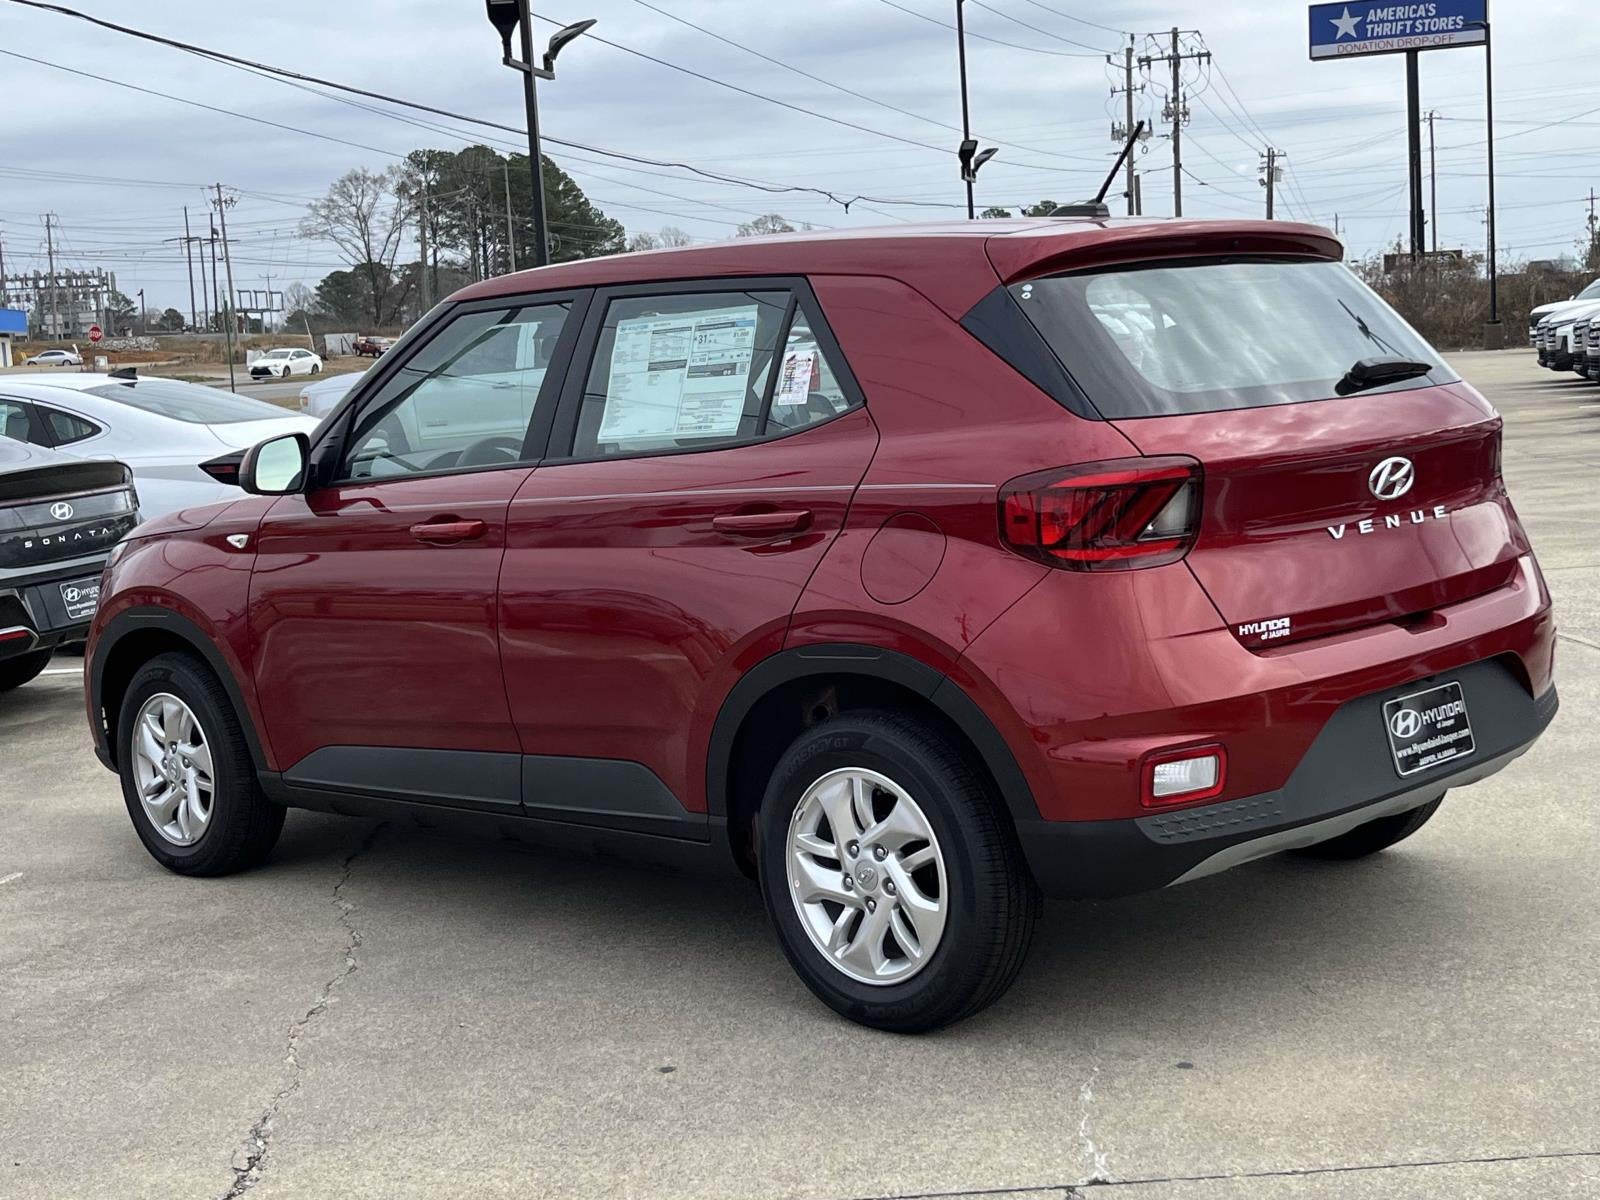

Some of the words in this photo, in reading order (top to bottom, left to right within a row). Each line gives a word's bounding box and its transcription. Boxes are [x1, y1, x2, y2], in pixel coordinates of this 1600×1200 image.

[1366, 4, 1436, 23] AMERICA'S
[1366, 19, 1416, 38] THRIFT
[1415, 16, 1464, 33] STORES
[1336, 37, 1394, 54] DONATION
[1397, 33, 1456, 48] DROP-OFF
[89, 330, 102, 338] STOP
[1327, 505, 1447, 540] VENUE
[24, 527, 110, 549] SONATA
[1239, 617, 1291, 636] HYUNDAI
[1268, 628, 1291, 639] JASPER
[1421, 700, 1465, 725] HYUNDAI
